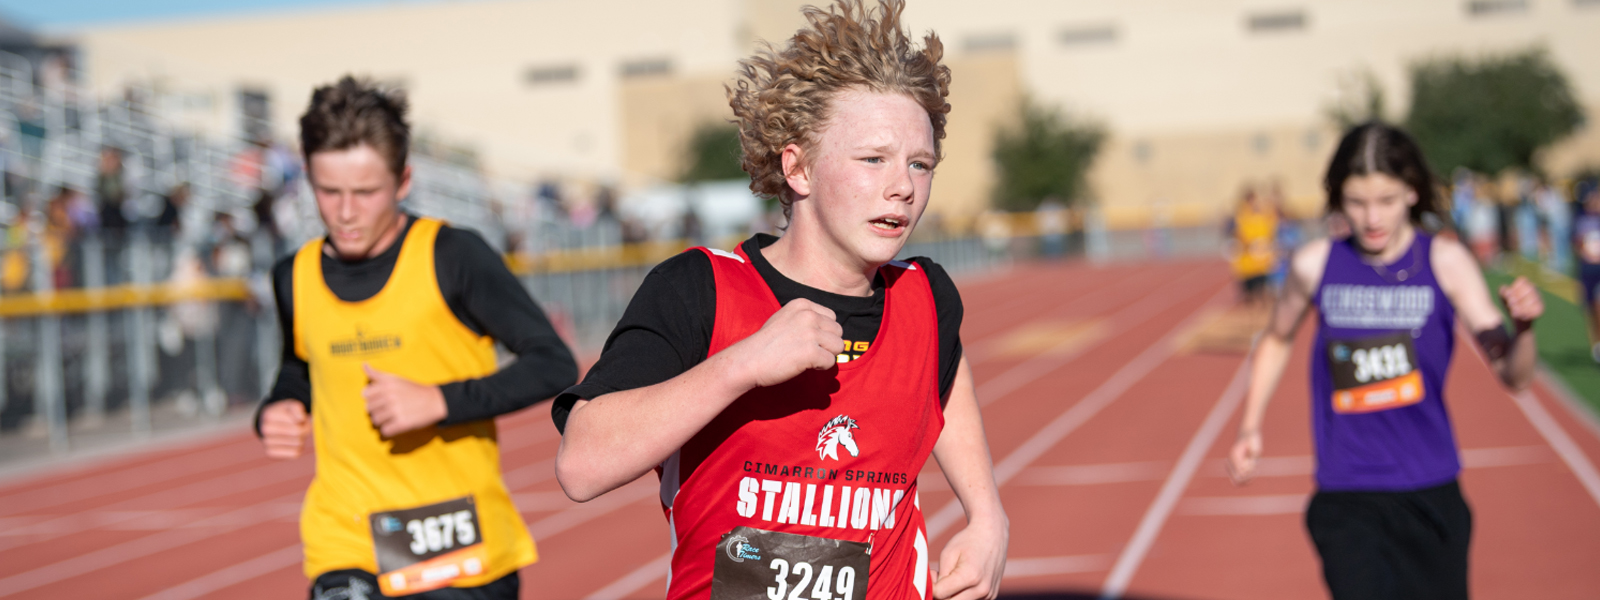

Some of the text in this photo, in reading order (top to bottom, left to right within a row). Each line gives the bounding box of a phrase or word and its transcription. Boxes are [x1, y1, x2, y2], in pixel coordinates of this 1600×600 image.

[743, 461, 908, 484] CIMARRON SPRINGS
[406, 510, 476, 555] 3675
[766, 558, 856, 600] 3249
